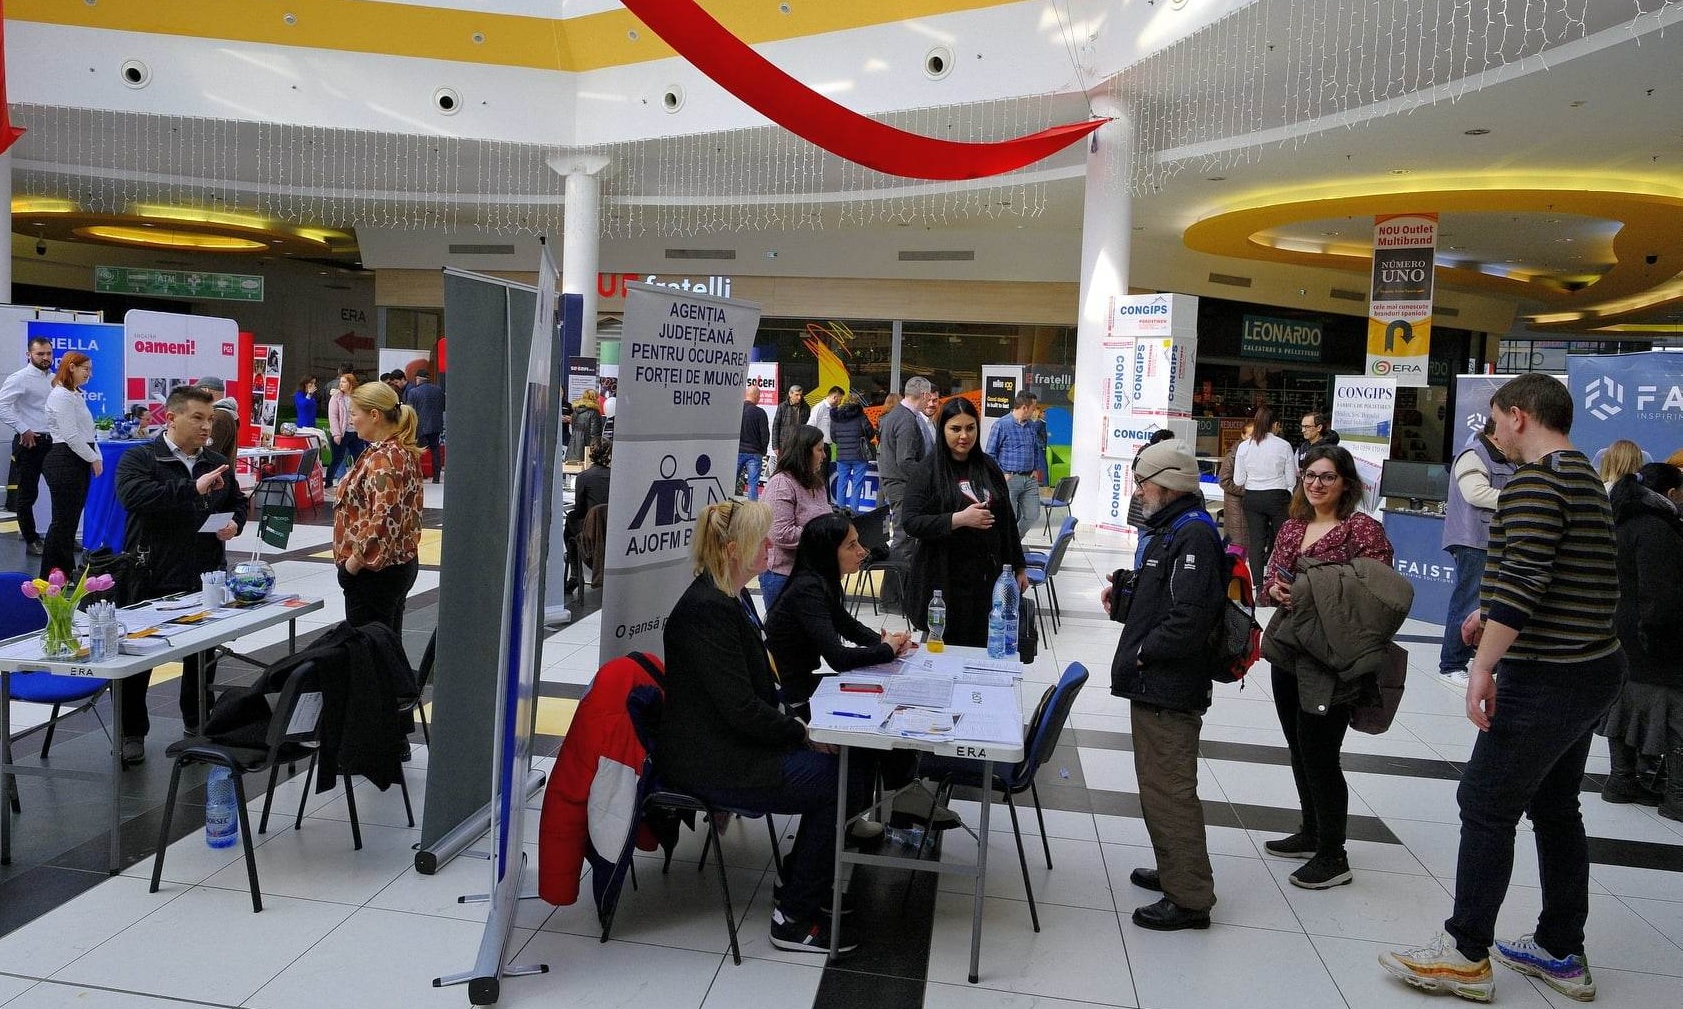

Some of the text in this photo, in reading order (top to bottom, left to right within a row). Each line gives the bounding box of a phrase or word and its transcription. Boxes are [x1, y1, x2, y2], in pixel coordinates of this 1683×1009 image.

[1379, 224, 1434, 236] NOU Outlet
[1378, 235, 1433, 246] Multibrand
[1381, 268, 1426, 283] UNO
[340, 307, 367, 323] ERA
[1120, 304, 1168, 315] CONGIPS
[1244, 320, 1322, 346] LEONARDO
[134, 339, 196, 356] oameni!
[631, 343, 748, 367] PENTRU OCUPAREA
[1133, 344, 1146, 401] CONGIPS
[1168, 344, 1179, 402] CONGIPS
[1393, 365, 1422, 373] ERA
[635, 365, 683, 389] FORȚEI
[685, 369, 700, 385] DE
[1034, 373, 1072, 385] fratelli
[1113, 355, 1125, 410] CONGIPS
[673, 390, 711, 406] BIHOR
[1337, 386, 1393, 400] CONGIPS
[1221, 420, 1244, 429] REDUCER
[1113, 428, 1153, 441] CONGIP
[1111, 463, 1122, 518] CONGIPS
[625, 530, 681, 557] AJOFM
[1398, 559, 1455, 579] FAIST
[615, 624, 626, 639] O
[70, 666, 94, 677] ERA
[956, 746, 987, 758] ERA
